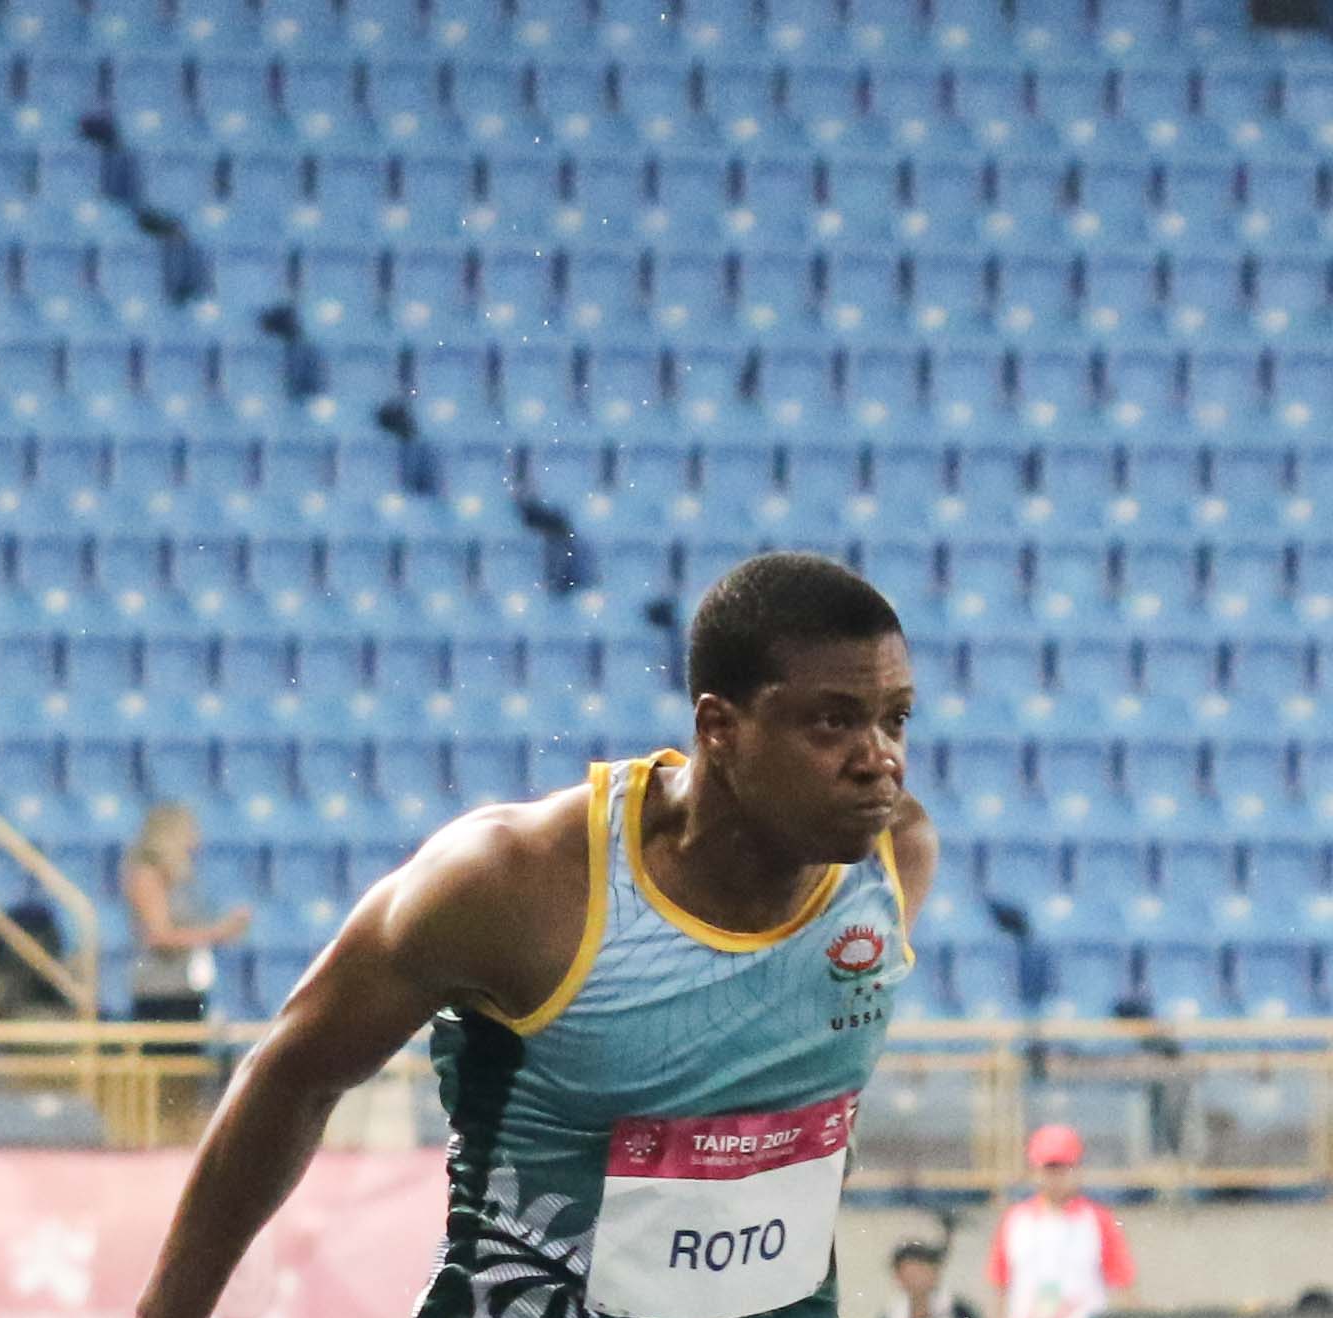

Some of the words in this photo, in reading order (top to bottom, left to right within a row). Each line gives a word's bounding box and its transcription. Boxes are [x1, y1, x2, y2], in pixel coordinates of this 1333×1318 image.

[830, 1007, 883, 1030] USSA
[693, 1134, 757, 1154] TAIPEI
[761, 1127, 803, 1150] 2017
[669, 1218, 786, 1272] ROTO
